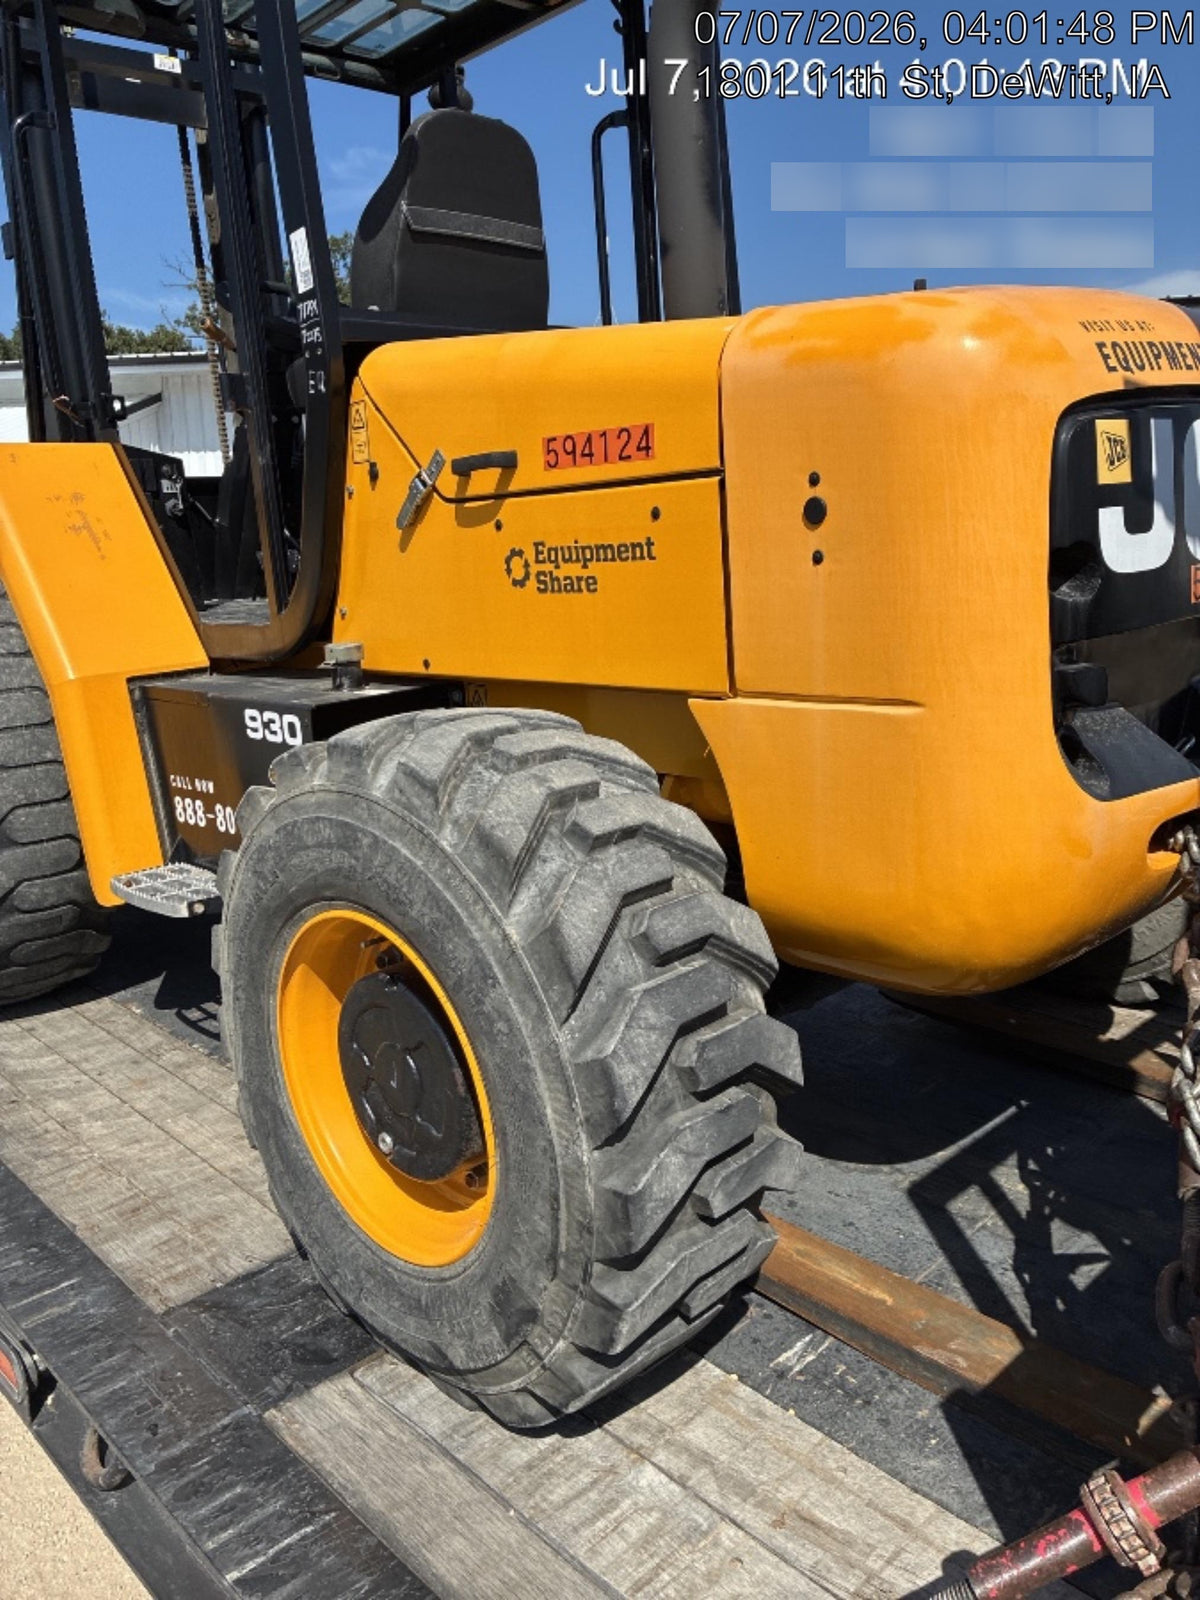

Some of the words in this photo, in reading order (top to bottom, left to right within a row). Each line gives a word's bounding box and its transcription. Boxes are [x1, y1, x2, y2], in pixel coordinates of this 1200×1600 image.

[1079, 319, 1116, 333] VISIT
[1115, 319, 1136, 331] US
[546, 425, 652, 469] 594124
[533, 536, 657, 570] Equipment
[535, 570, 598, 594] Share
[244, 708, 303, 746] 930
[170, 774, 193, 791] CALL
[195, 777, 214, 794] NOW
[174, 795, 236, 835] 888-80
